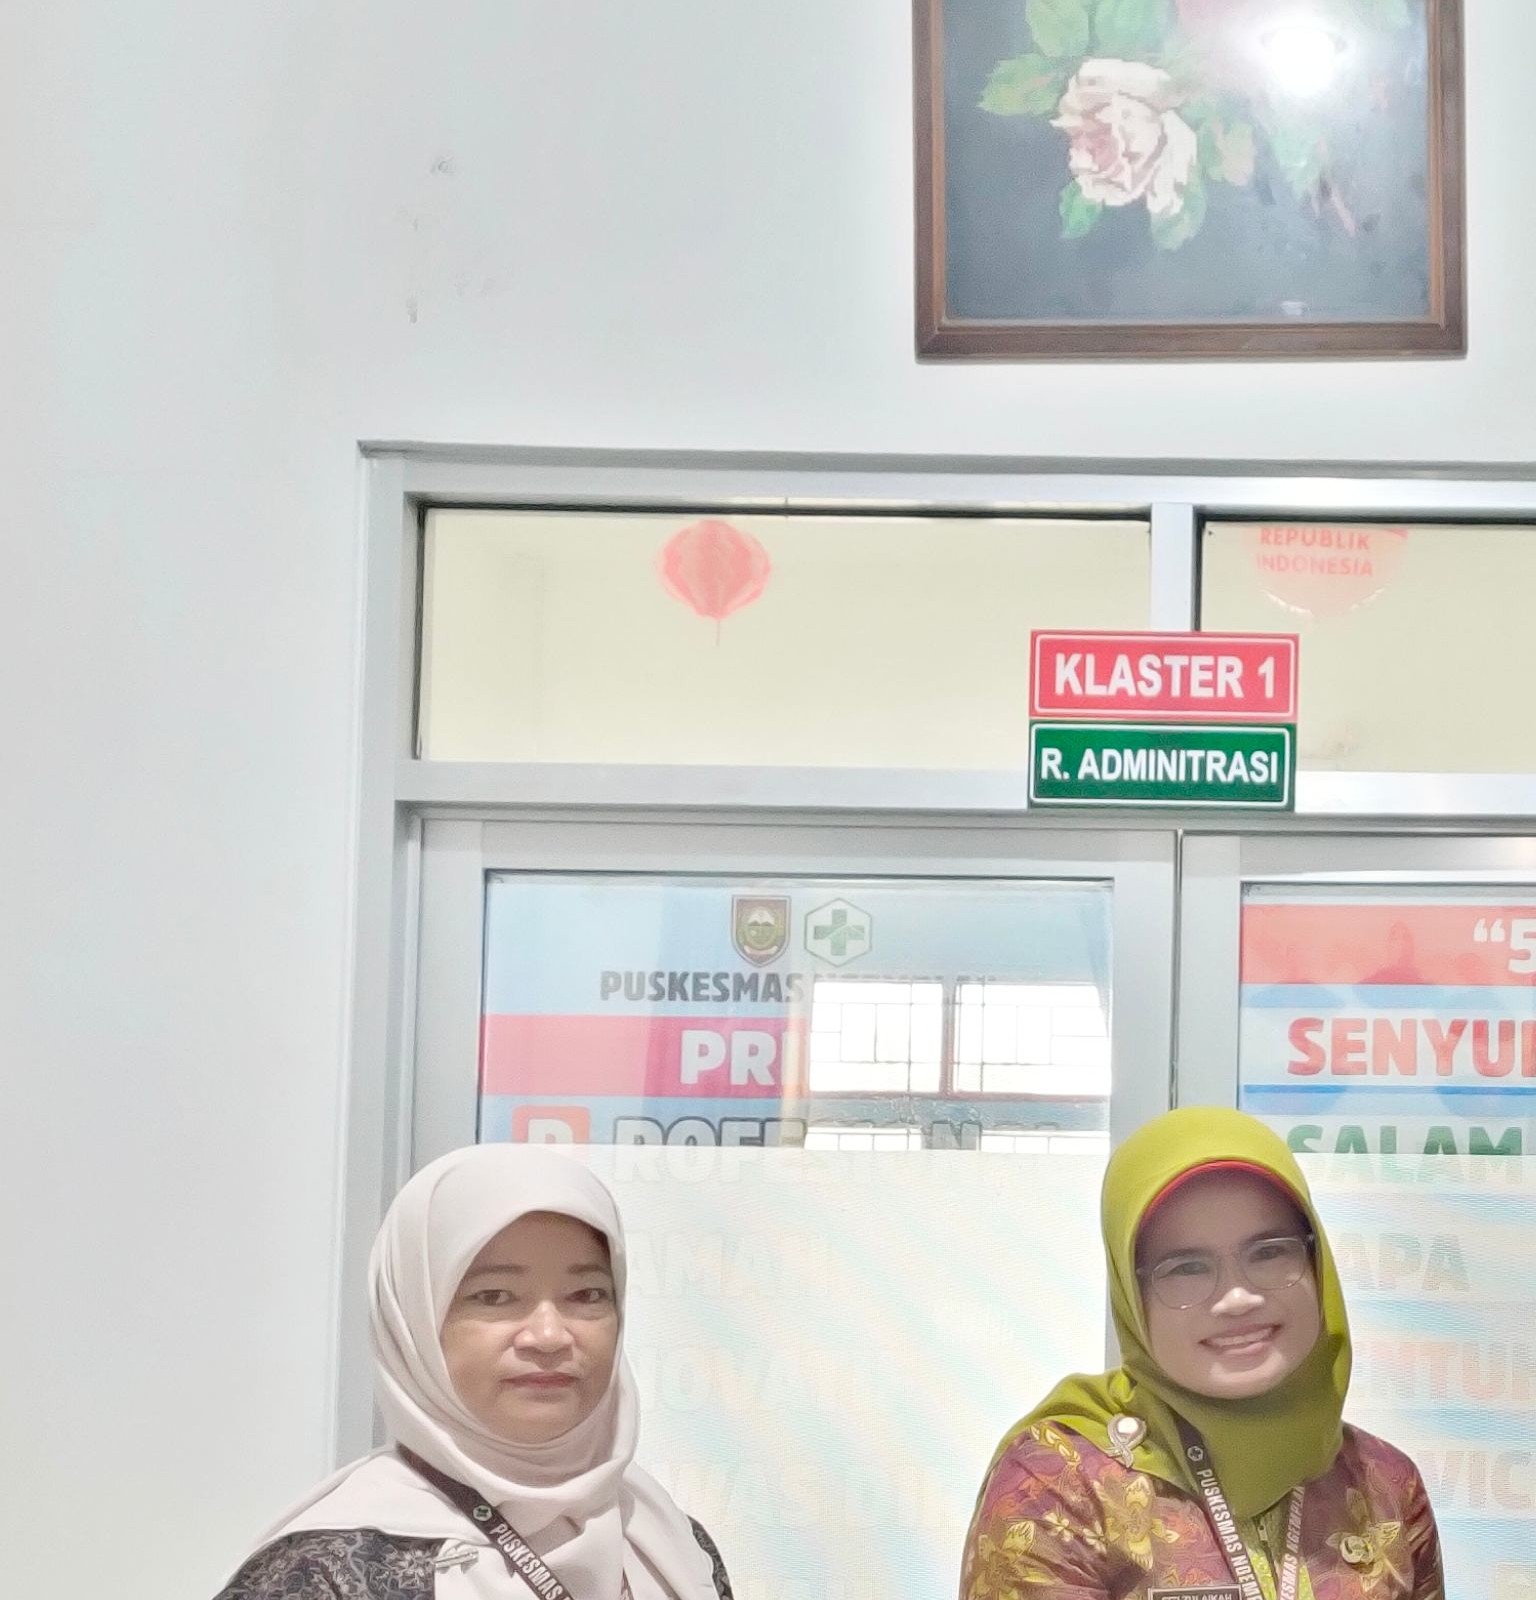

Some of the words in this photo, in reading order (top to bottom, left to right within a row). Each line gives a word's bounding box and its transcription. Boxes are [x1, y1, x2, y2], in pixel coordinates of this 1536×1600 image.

[1260, 527, 1370, 551] REPUBLIK
[1257, 554, 1373, 577] INDONESIA
[1054, 652, 1244, 699] KLASTER
[1257, 656, 1275, 699] 1
[1040, 748, 1070, 781] R.
[1077, 748, 1278, 784] ADMINITRASI
[601, 970, 805, 1002] PUSKESMAS
[1196, 1468, 1243, 1554] PUSKESMAS
